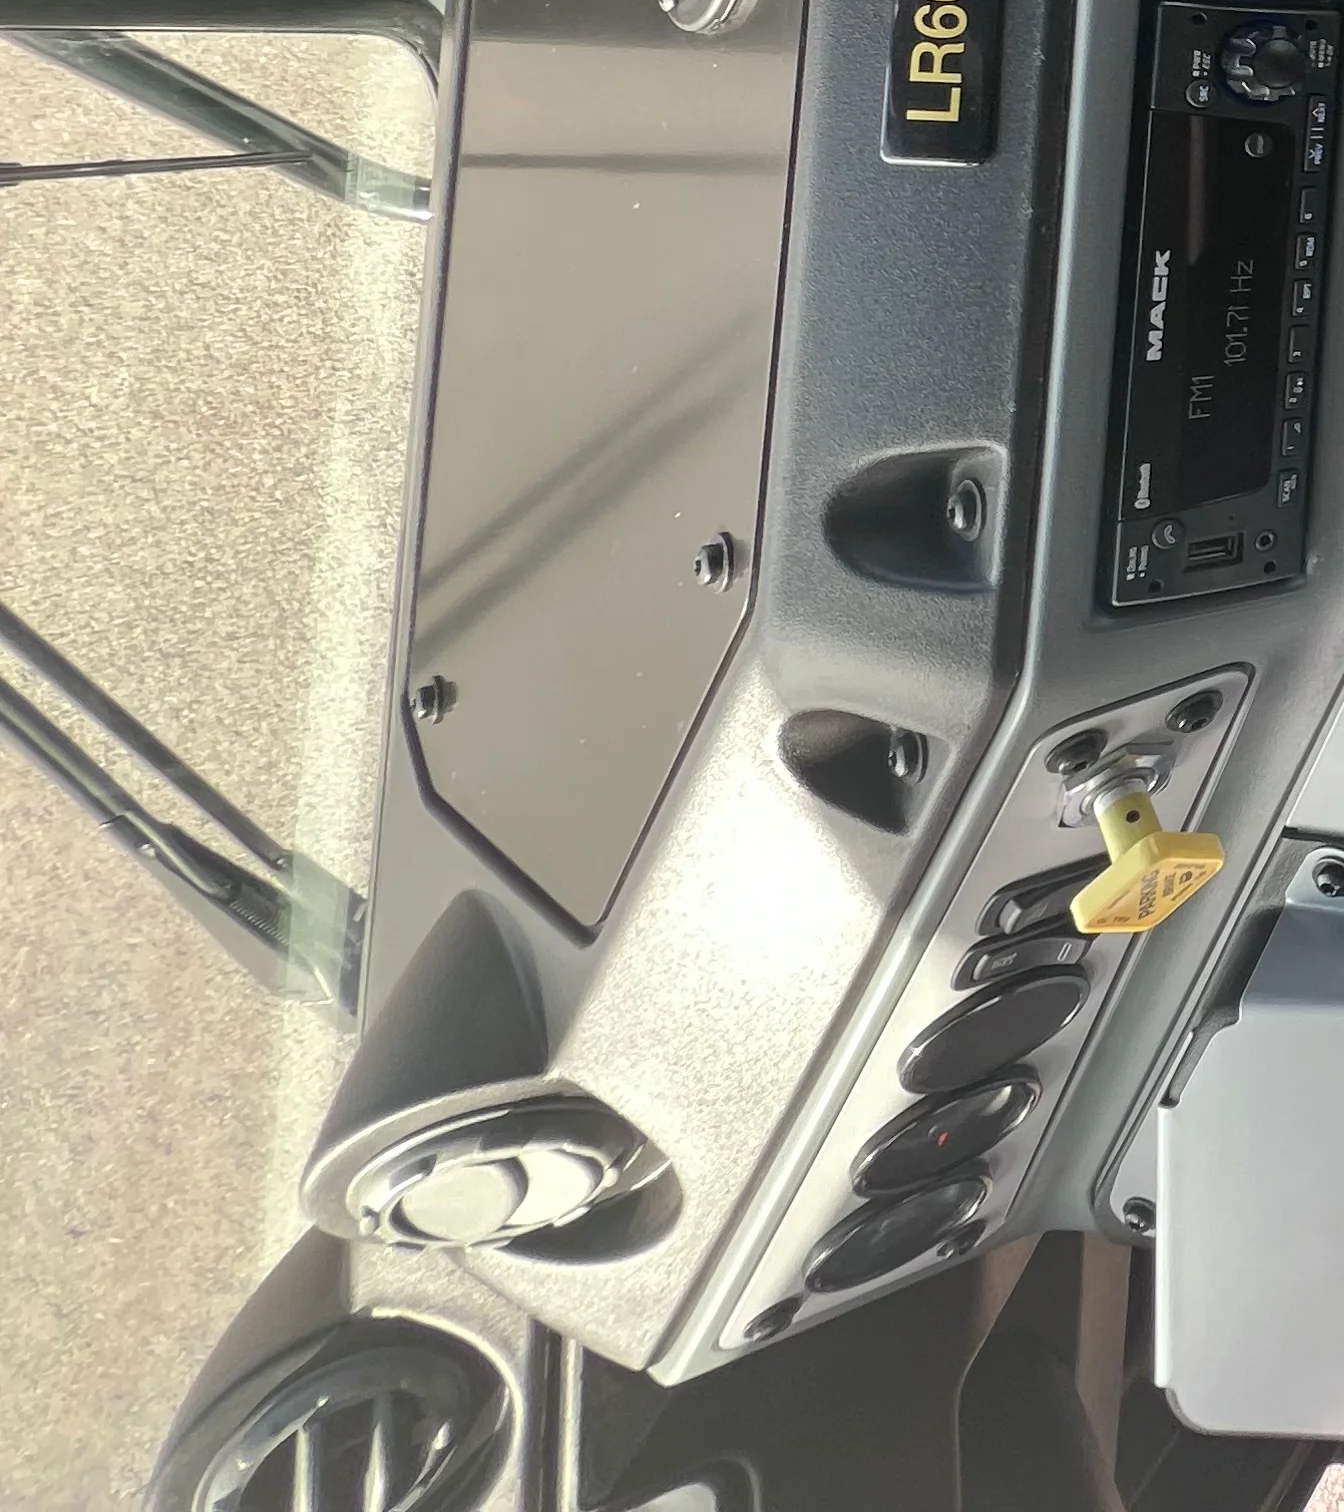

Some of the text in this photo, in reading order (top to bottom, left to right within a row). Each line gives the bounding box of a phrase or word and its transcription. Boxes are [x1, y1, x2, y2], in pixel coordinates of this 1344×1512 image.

[1146, 249, 1171, 361] MACK
[1188, 375, 1215, 420] FM1
[1137, 869, 1160, 920] PARKING
